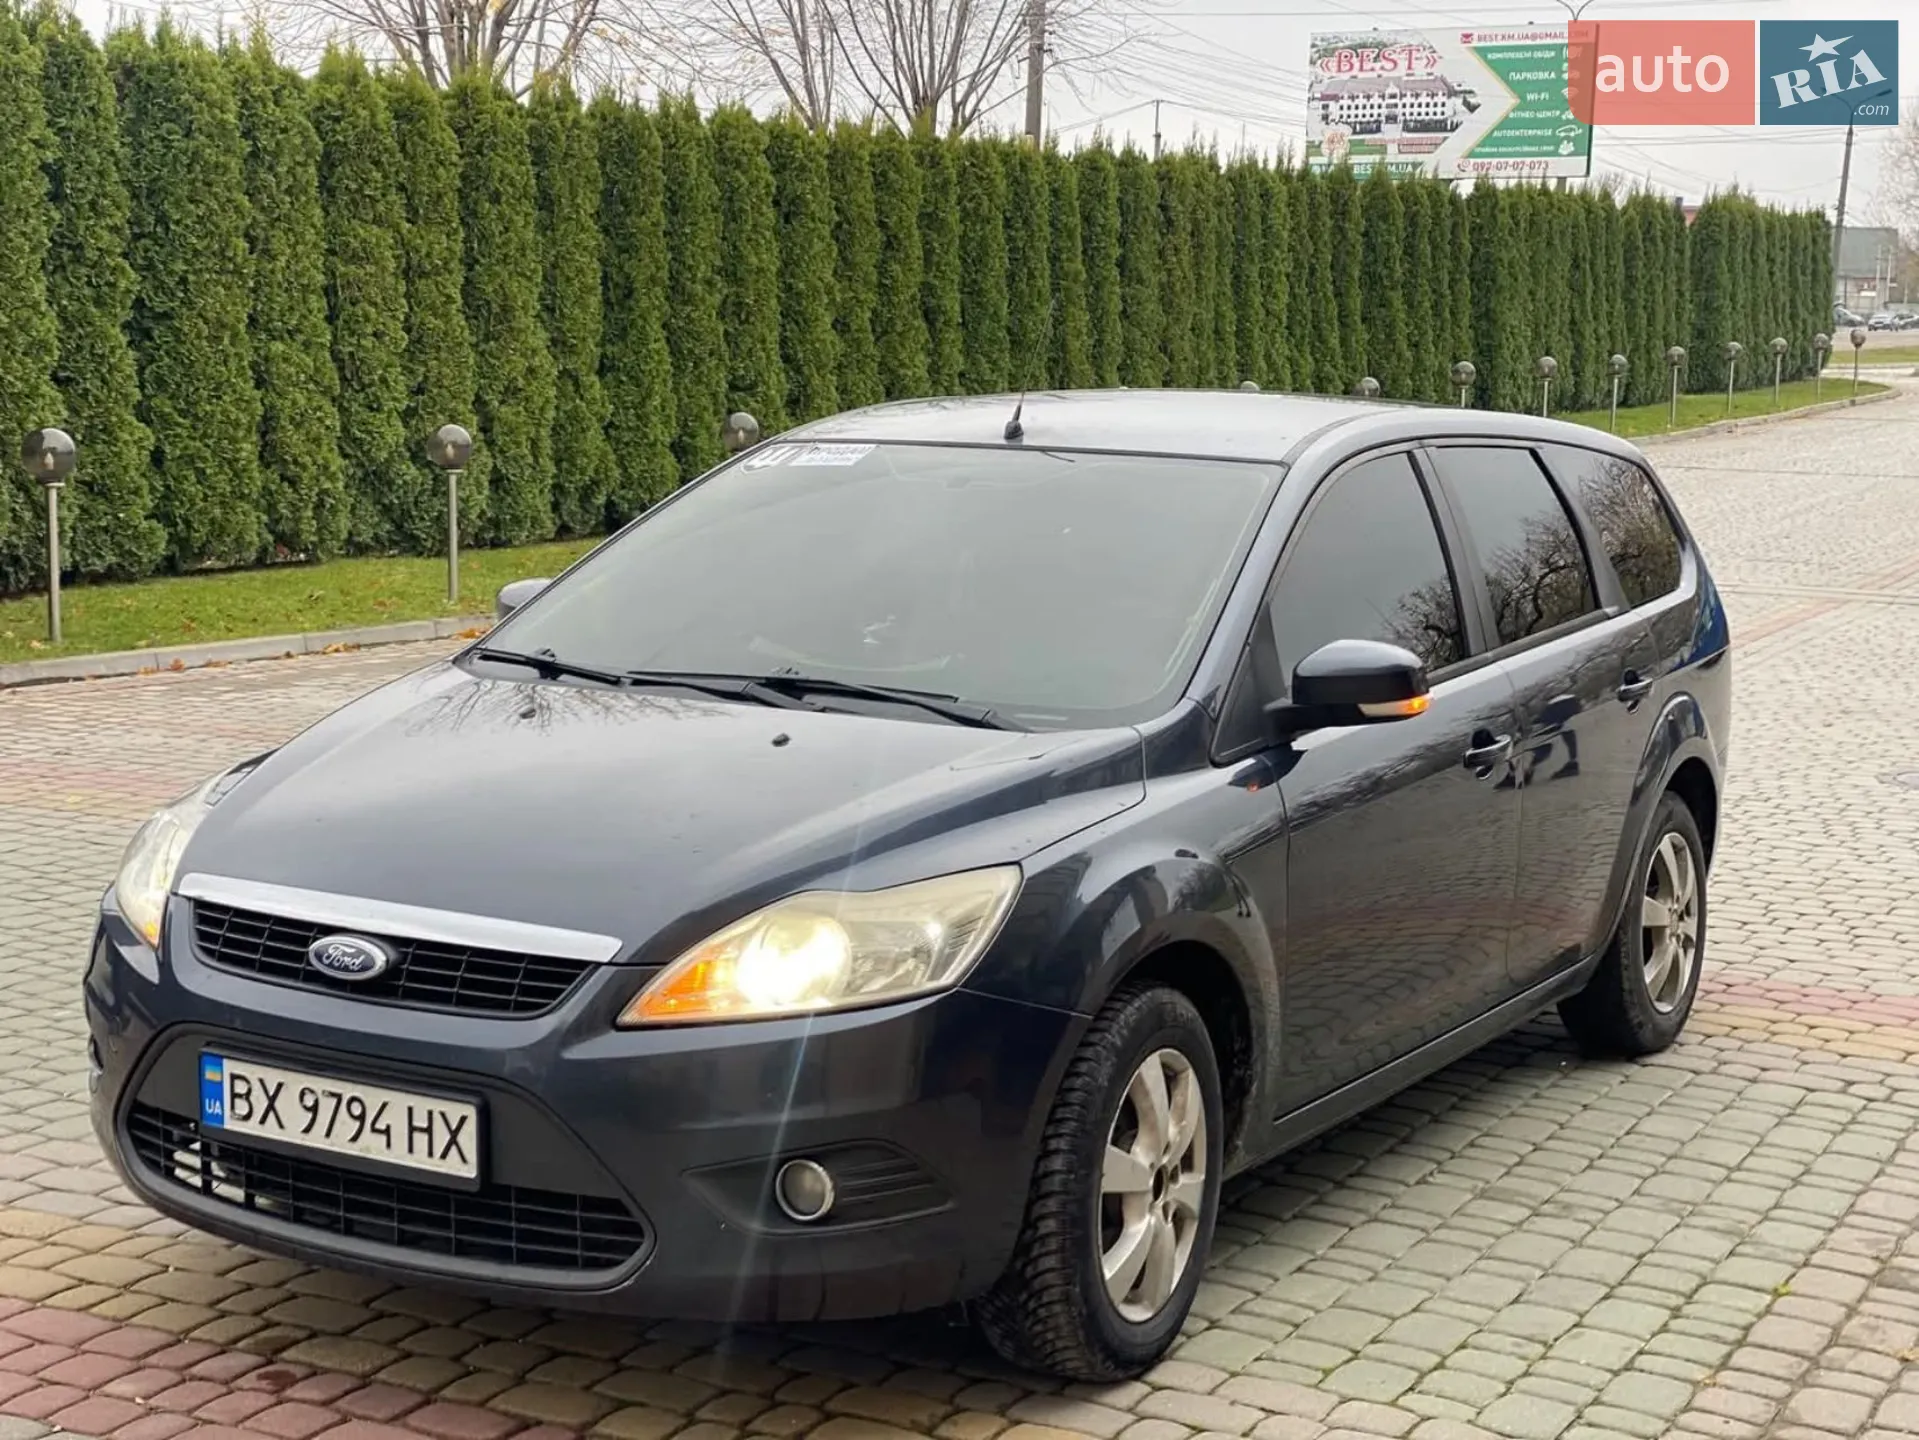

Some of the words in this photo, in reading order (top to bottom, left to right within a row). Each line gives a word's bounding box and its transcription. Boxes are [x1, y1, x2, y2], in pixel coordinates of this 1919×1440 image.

[1508, 71, 1556, 81] ПАРКОВКА
[1526, 92, 1550, 101] WI-FI
[322, 944, 365, 971] Ford
[205, 1098, 222, 1116] UA
[229, 1072, 285, 1130] BX
[298, 1086, 392, 1150] 9794
[406, 1105, 469, 1165] HX
